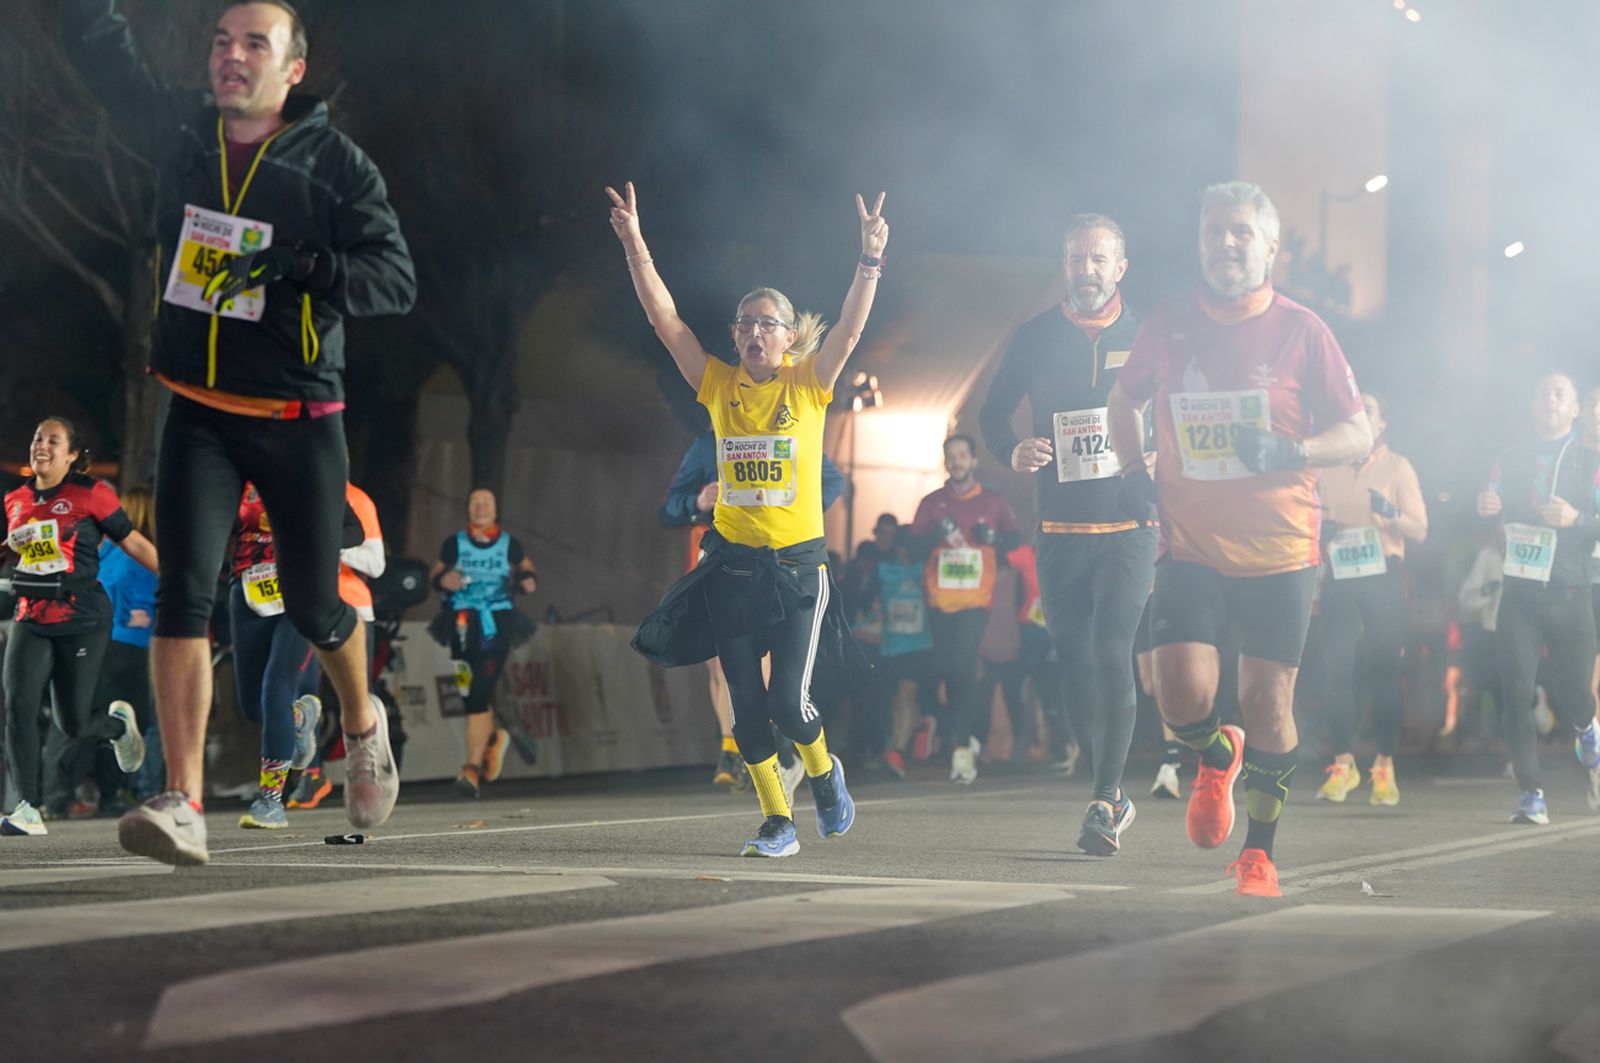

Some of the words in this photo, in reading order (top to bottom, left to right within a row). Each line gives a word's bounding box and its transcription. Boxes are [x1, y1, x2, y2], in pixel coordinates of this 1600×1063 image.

[1070, 417, 1091, 426] NOCHE
[1182, 414, 1198, 422] SAN
[1062, 427, 1077, 436] SAN
[1077, 424, 1103, 435] ANTÓN
[726, 453, 742, 461] SAN
[743, 451, 768, 459] ANTÓN
[734, 461, 782, 482] 8805
